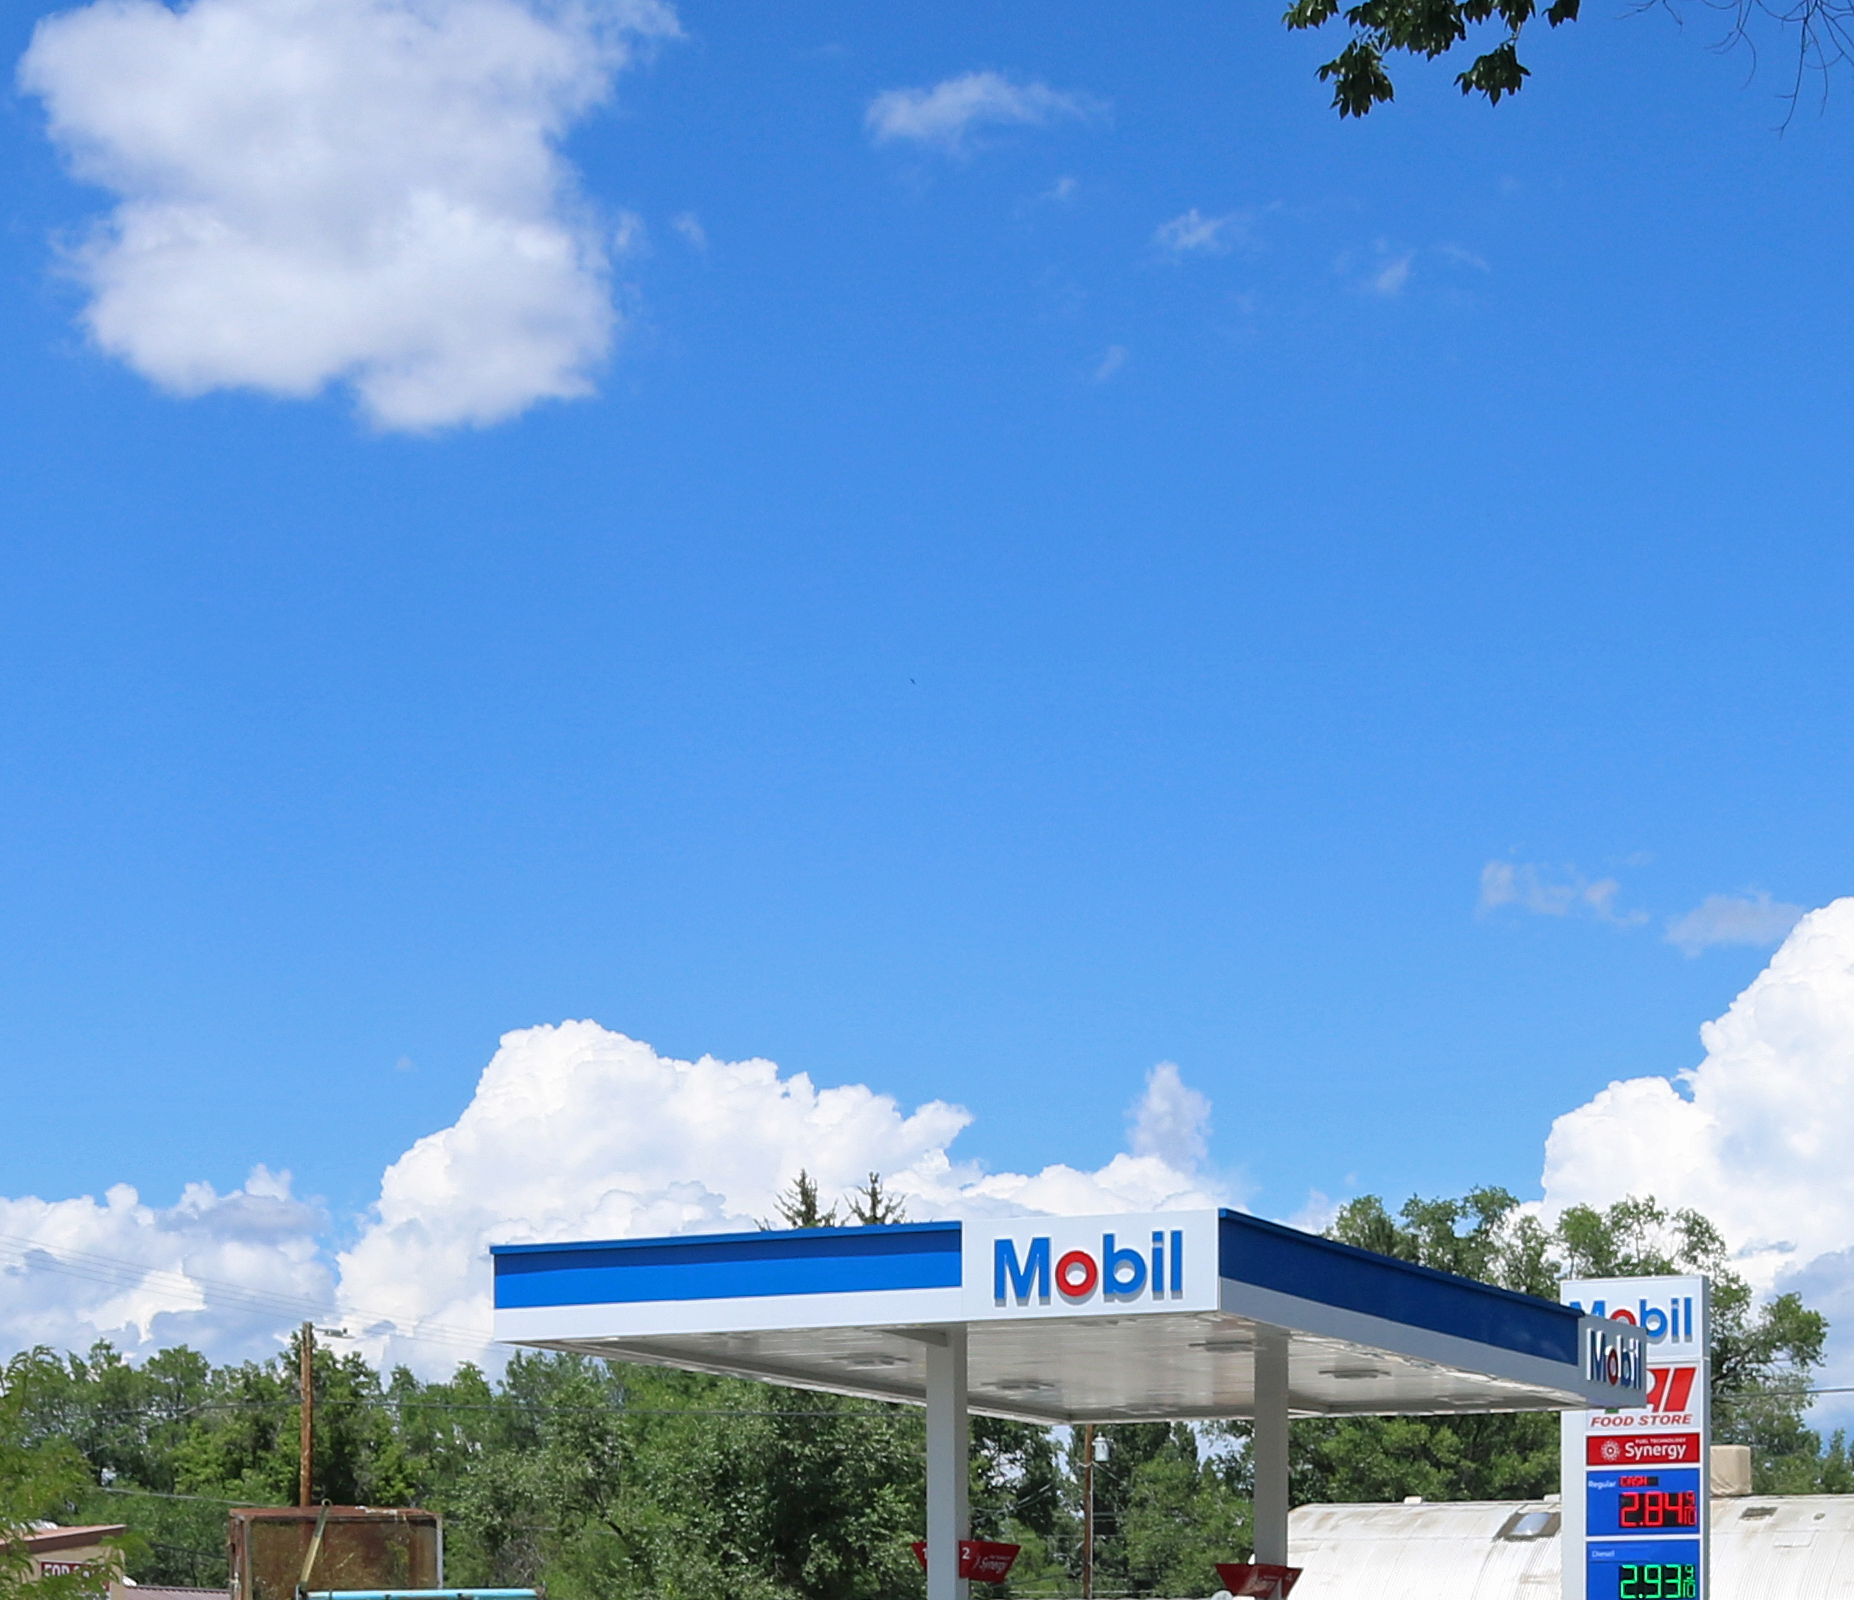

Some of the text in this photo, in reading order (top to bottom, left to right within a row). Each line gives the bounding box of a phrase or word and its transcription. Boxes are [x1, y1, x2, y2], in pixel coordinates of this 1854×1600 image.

[994, 1229, 1183, 1307] Mobil
[1587, 1327, 1642, 1390] Mobil
[1590, 1414, 1692, 1427] FOOD STORE
[1625, 1442, 1687, 1461] Synergy
[1588, 1481, 1616, 1489] Regular
[1621, 1492, 1684, 1527] 2.84
[962, 1547, 970, 1559] 2
[1621, 1564, 1682, 1599] 2.93
